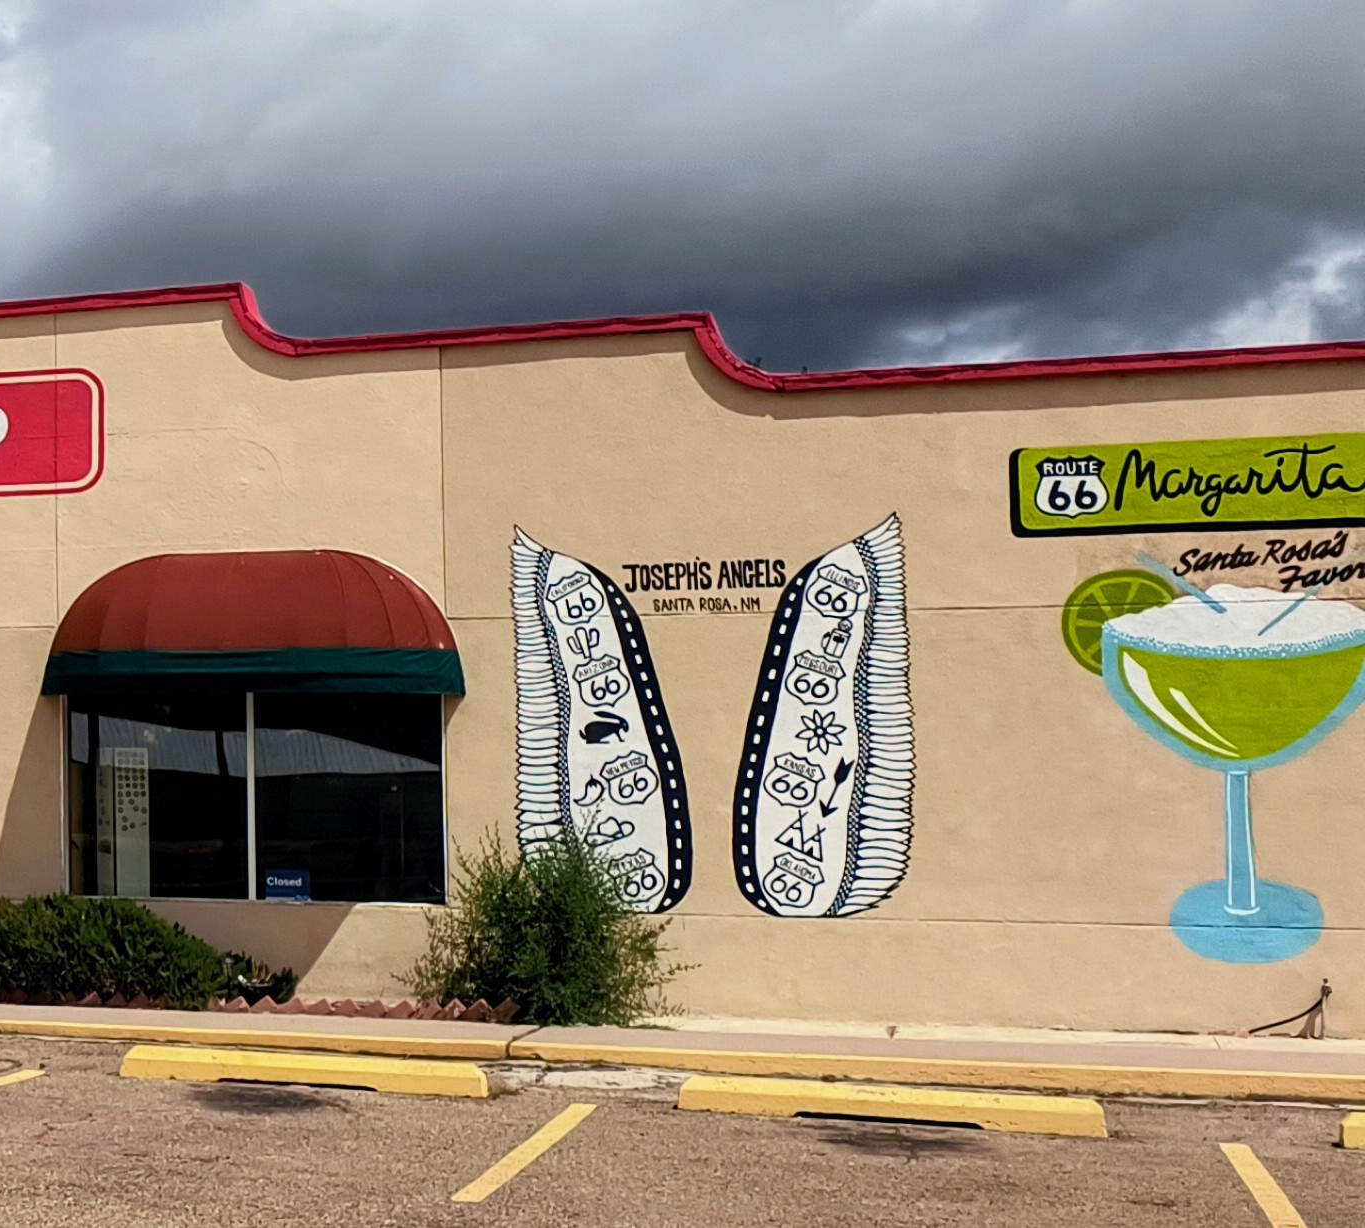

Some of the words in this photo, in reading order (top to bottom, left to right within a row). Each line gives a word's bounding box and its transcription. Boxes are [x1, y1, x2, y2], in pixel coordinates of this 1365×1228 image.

[1043, 460, 1099, 476] ROUTE
[1113, 443, 1365, 517] Margarita
[1048, 479, 1099, 511] 66
[1173, 544, 1260, 577] Santa
[1260, 530, 1349, 567] Rosa's
[622, 556, 712, 593] JOSEPH'S
[717, 559, 787, 589] ANGELS
[565, 591, 596, 619] 66
[653, 598, 695, 612] SANTA
[741, 597, 761, 612] NM
[815, 584, 848, 613] 66
[578, 659, 615, 678] ARIZONA
[591, 674, 621, 700] 66
[794, 672, 830, 699] 66
[783, 758, 817, 779] KANSAS
[618, 771, 649, 799] 66
[771, 773, 809, 801] 66
[266, 876, 303, 887] Closed
[624, 869, 657, 898] 66
[770, 873, 802, 903] 66
